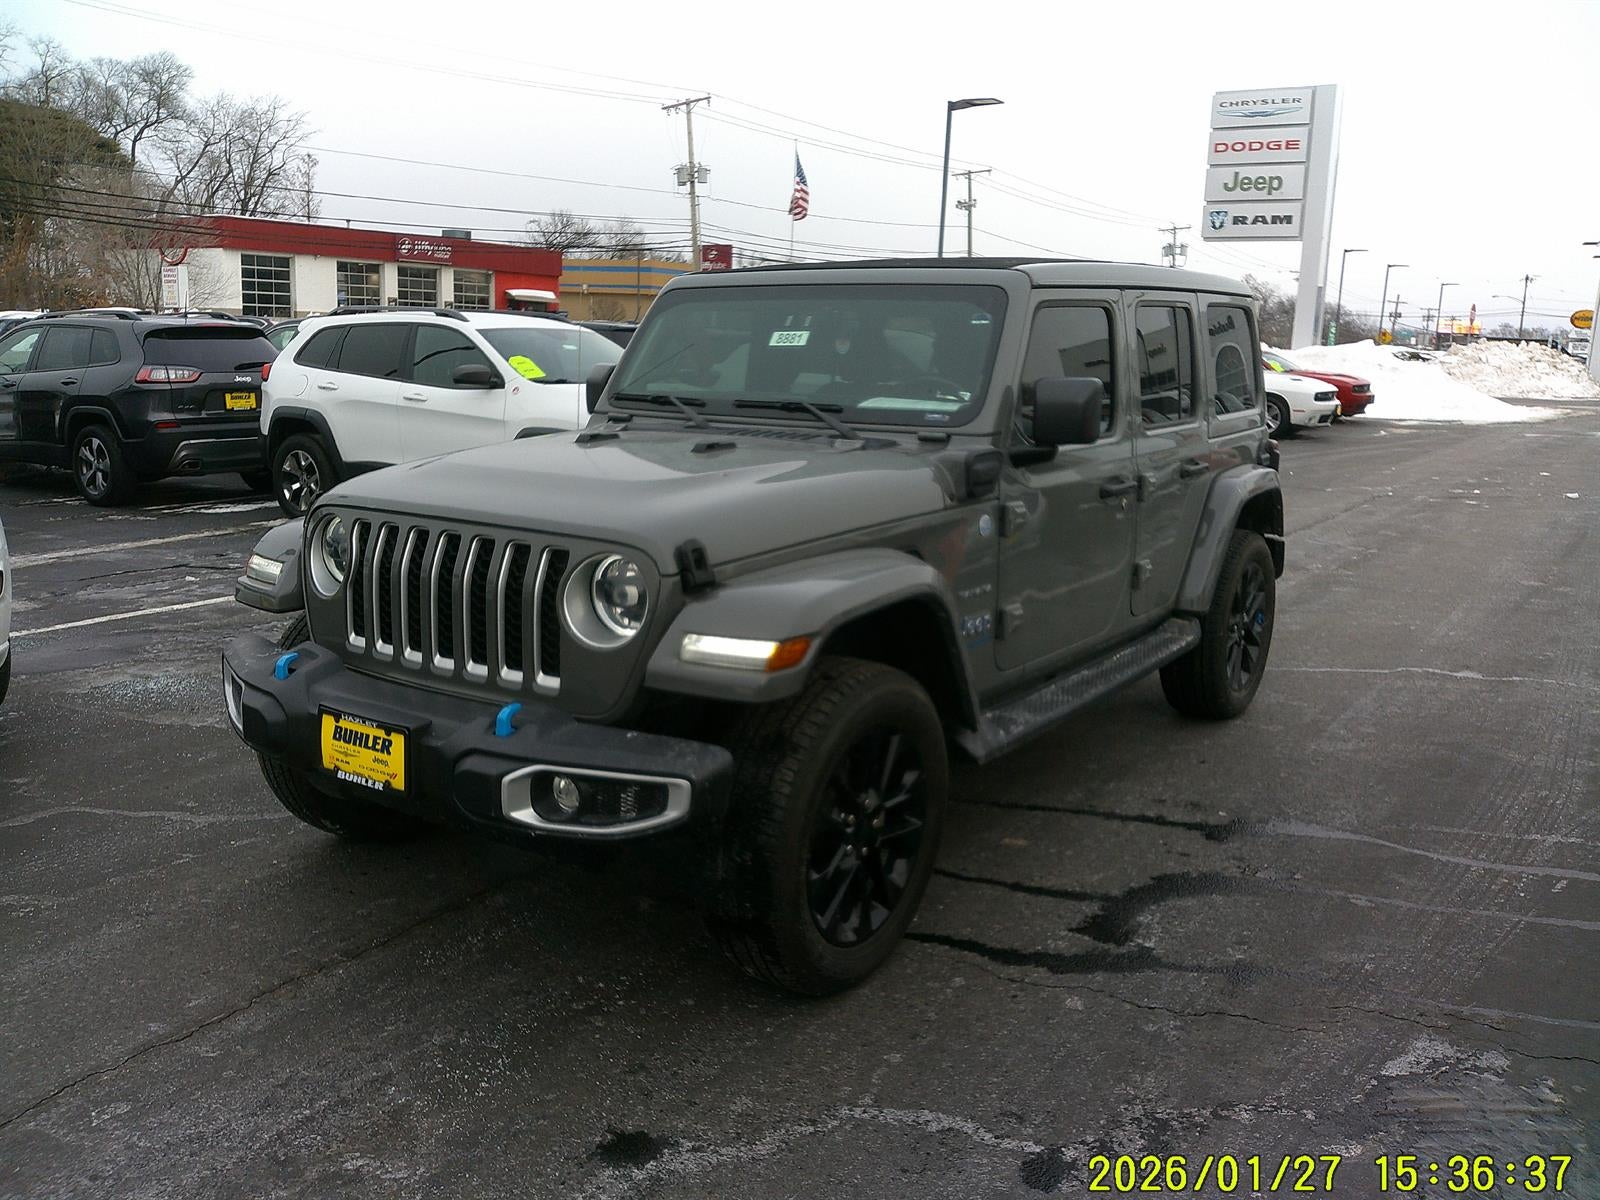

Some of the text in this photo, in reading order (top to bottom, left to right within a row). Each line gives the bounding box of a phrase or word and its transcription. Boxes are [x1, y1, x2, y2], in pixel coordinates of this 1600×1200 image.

[1219, 97, 1303, 108] CHRYSLER
[1214, 140, 1301, 153] DODGE
[1223, 171, 1284, 195] Jeep
[1232, 214, 1293, 225] RAM
[233, 375, 252, 383] Jeep
[341, 713, 379, 729] HAZLET
[332, 724, 393, 756] BUHLER
[371, 755, 389, 768] Jeep
[337, 769, 384, 791] BUHLER
